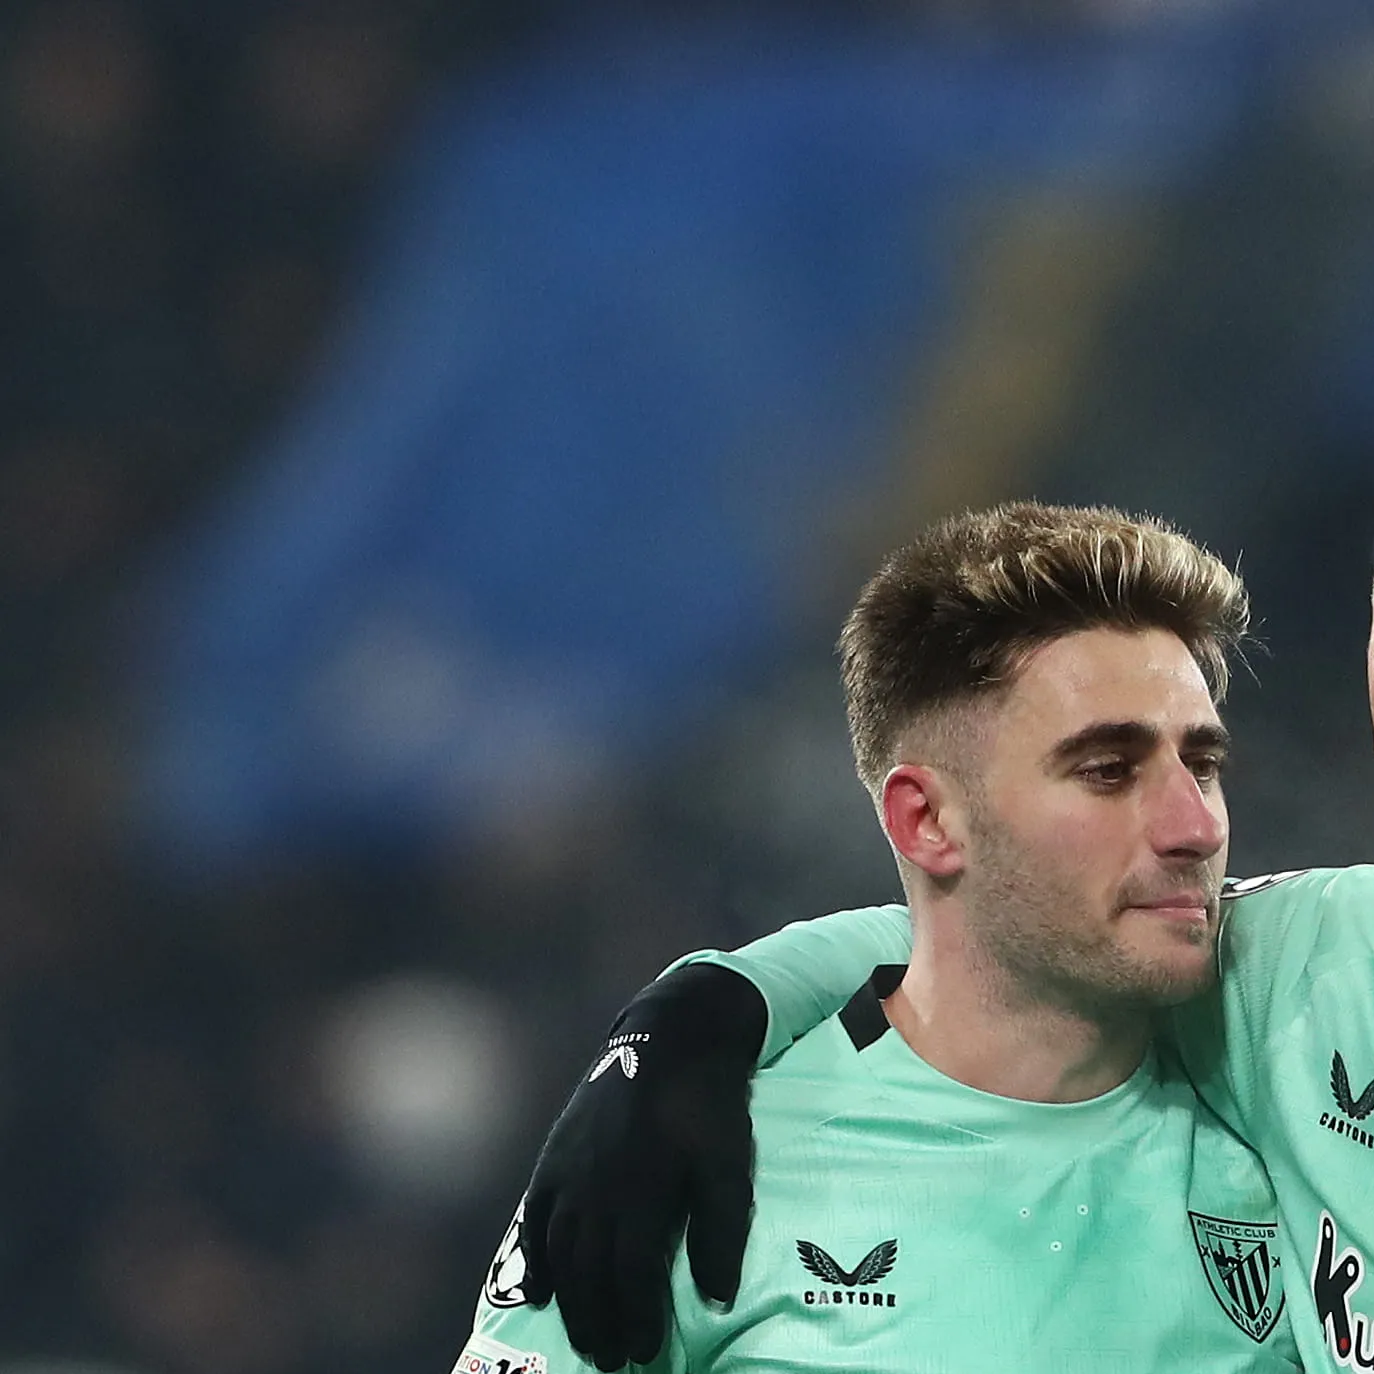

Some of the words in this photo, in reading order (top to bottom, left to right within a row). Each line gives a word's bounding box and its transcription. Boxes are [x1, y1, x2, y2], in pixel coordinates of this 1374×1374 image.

[1319, 1112, 1374, 1149] CASTORE
[1197, 1219, 1241, 1236] ATHLETIC
[1243, 1228, 1276, 1239] CLUB
[804, 1290, 897, 1308] CASTORE
[1231, 1303, 1273, 1337] BILBAO
